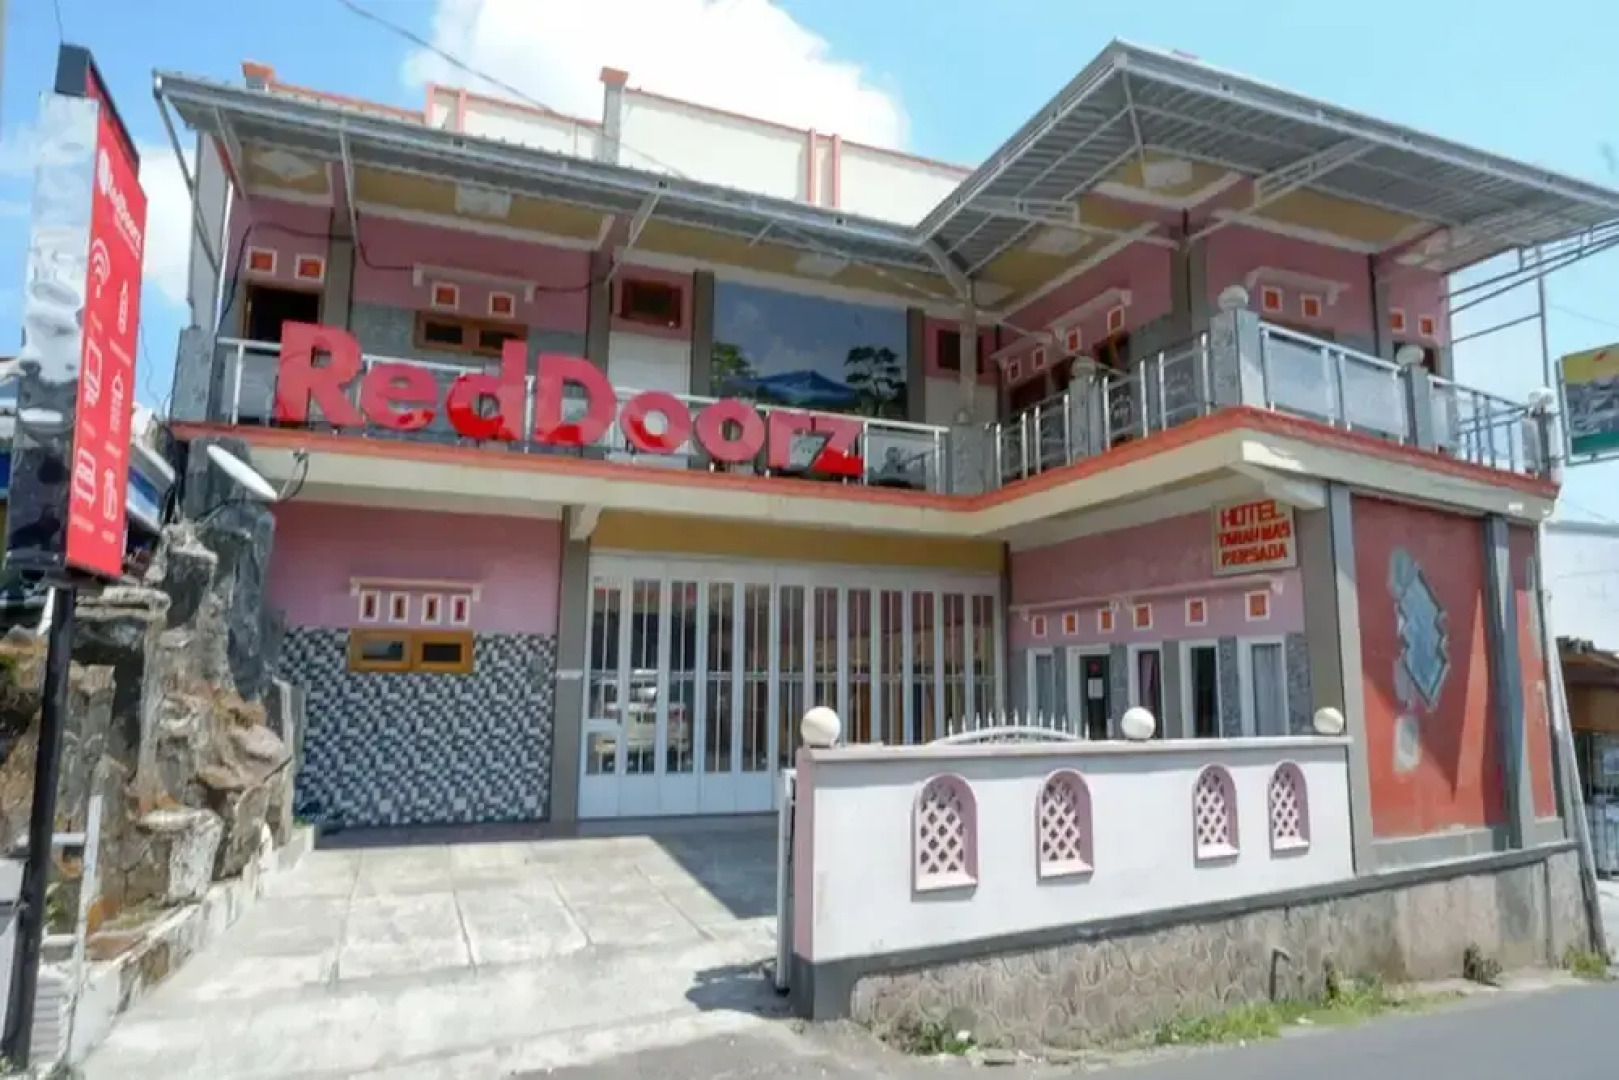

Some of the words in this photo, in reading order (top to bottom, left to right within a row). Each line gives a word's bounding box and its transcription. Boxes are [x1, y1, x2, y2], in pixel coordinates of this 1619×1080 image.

[275, 321, 863, 476] RedDoorz
[1221, 499, 1284, 530] HOTEL
[1221, 543, 1287, 568] PERSADA
